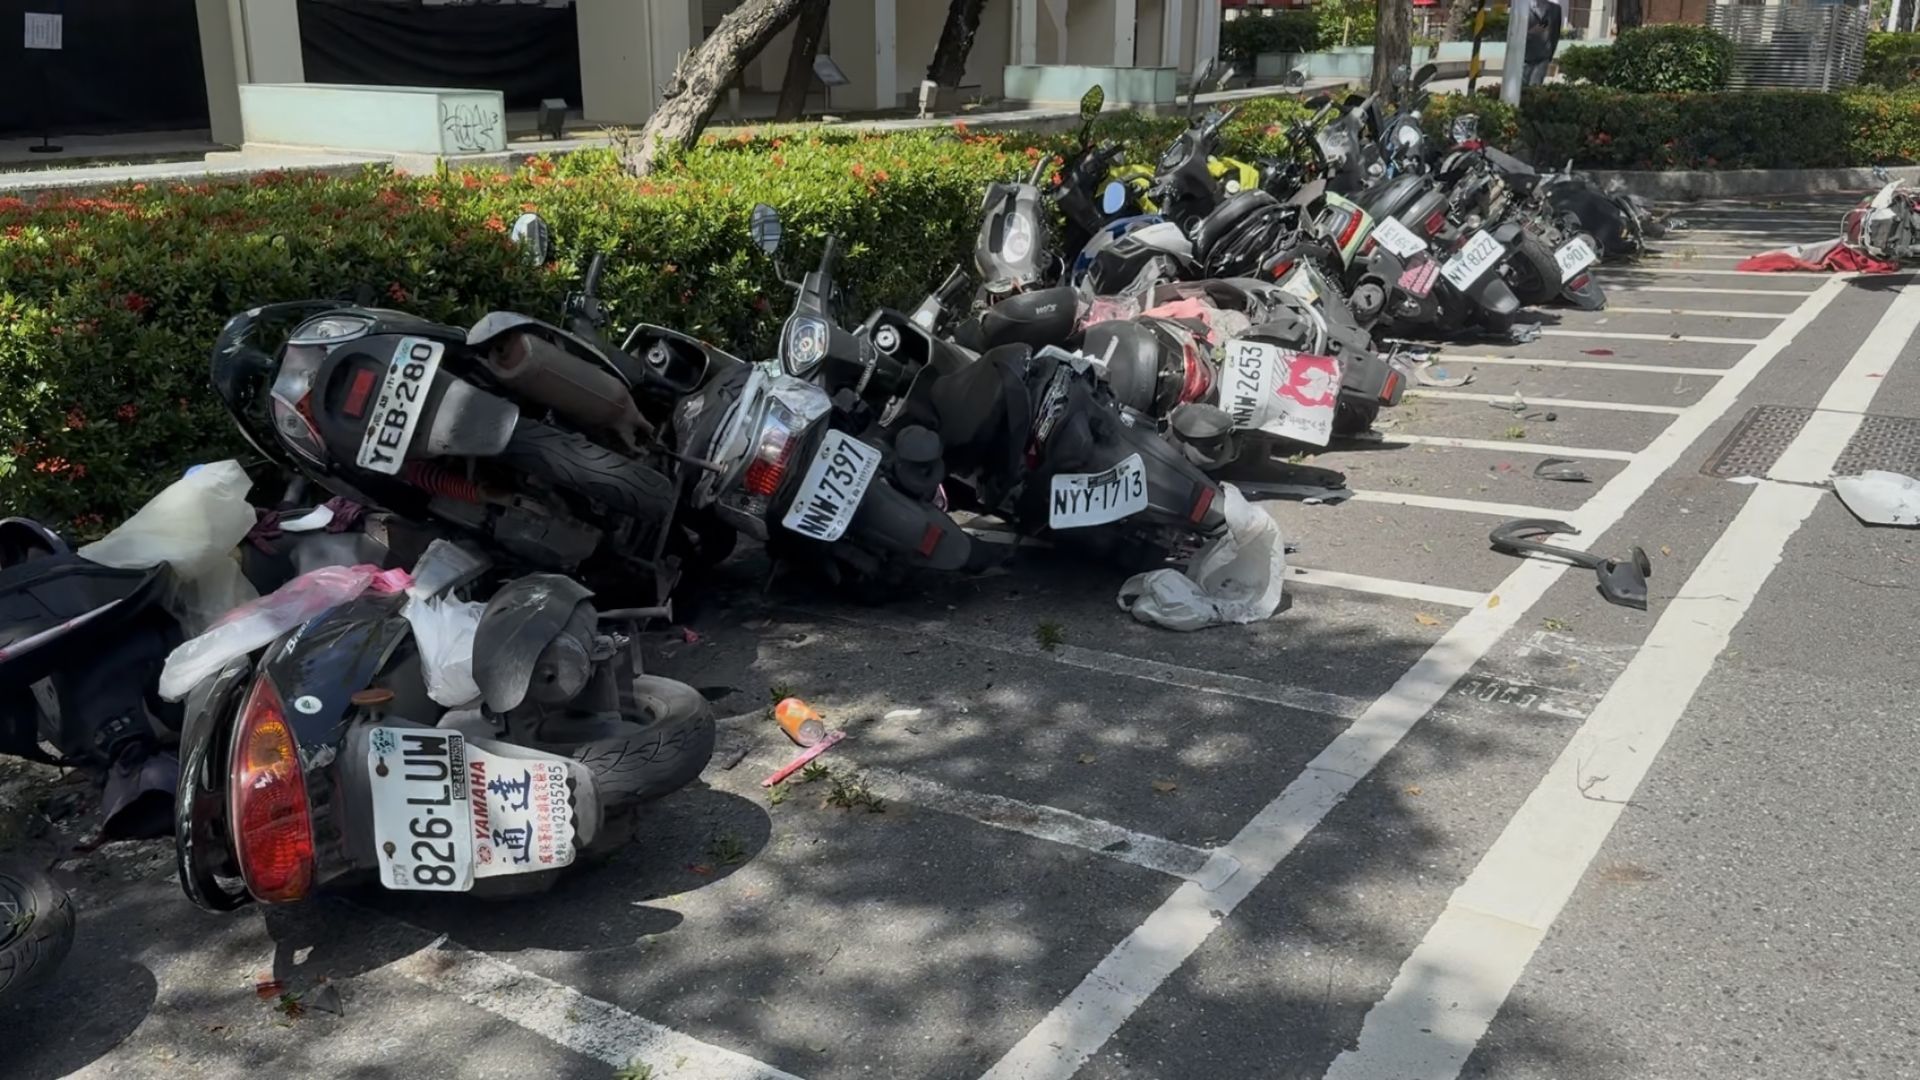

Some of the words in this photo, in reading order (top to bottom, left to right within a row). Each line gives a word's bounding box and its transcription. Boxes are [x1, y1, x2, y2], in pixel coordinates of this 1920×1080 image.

[369, 343, 432, 464] YEB-280
[469, 761, 490, 839] YAMAHA
[487, 768, 533, 865] 通達
[548, 765, 566, 822] 2355285
